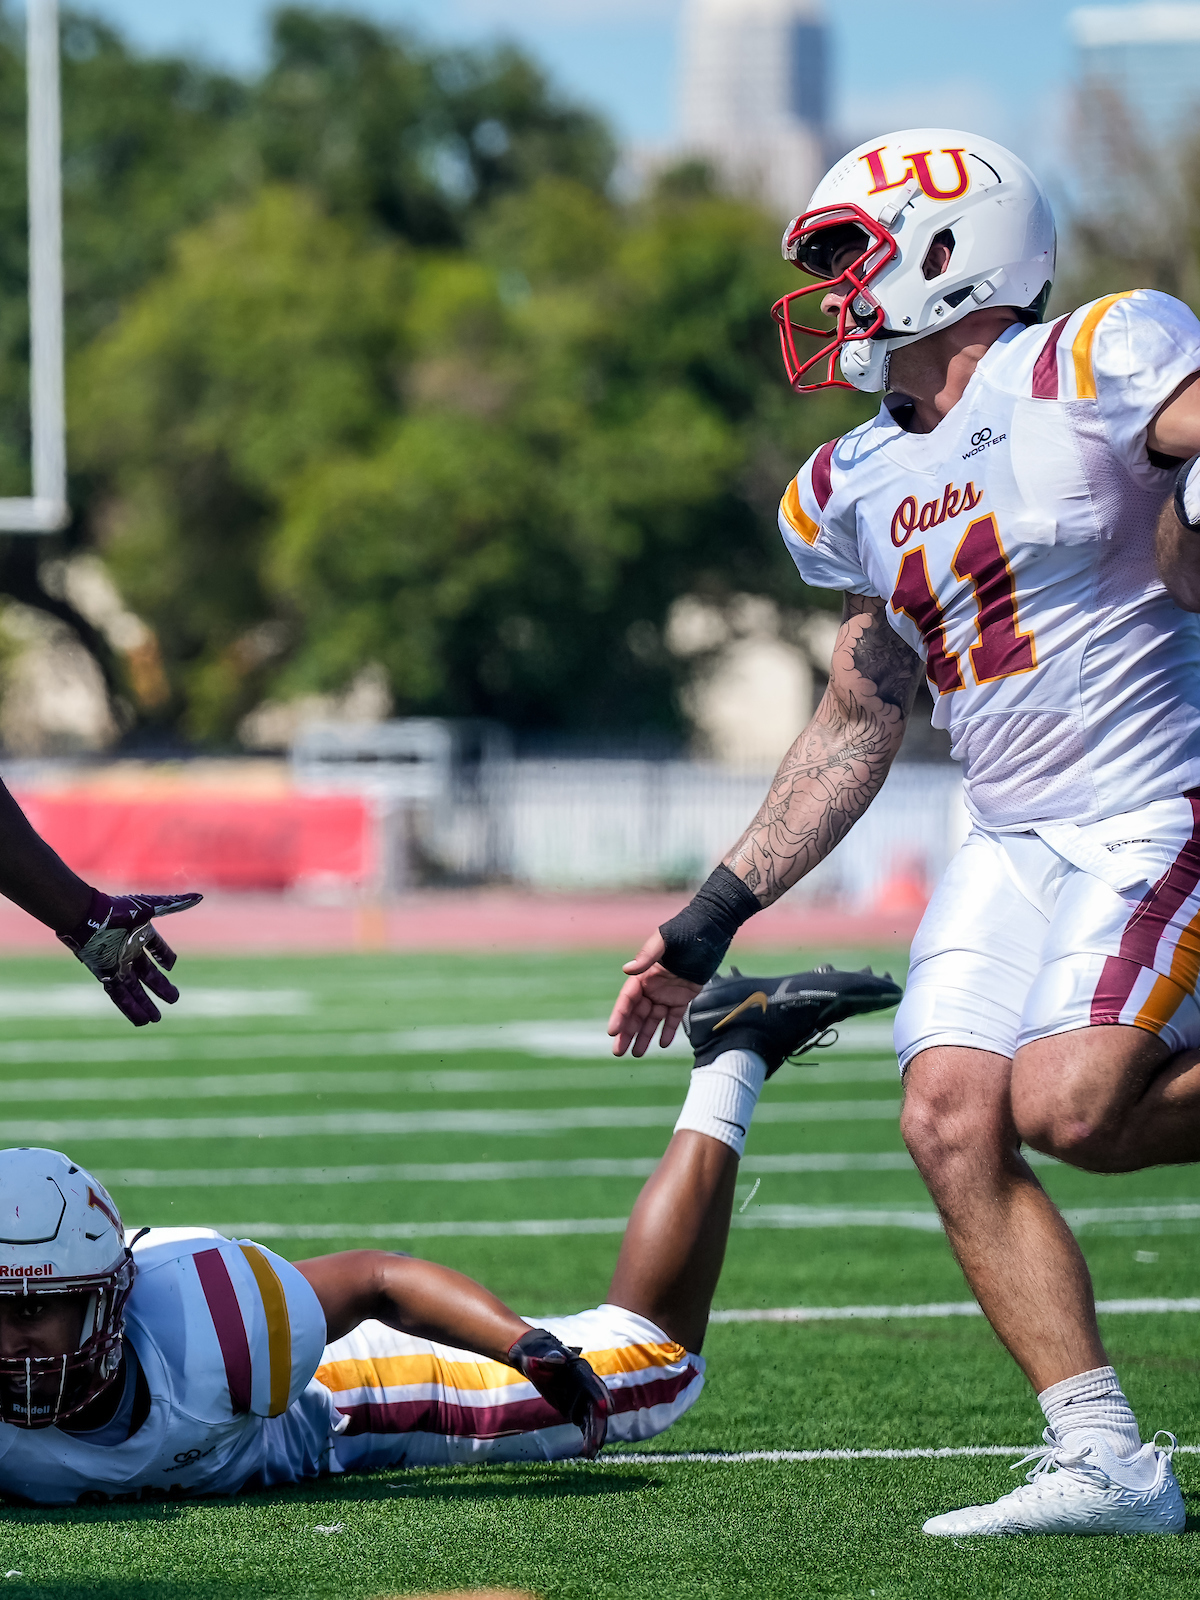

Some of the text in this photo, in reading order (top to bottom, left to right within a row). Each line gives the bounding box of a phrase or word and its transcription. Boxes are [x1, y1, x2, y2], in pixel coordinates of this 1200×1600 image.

[858, 145, 970, 201] LU
[962, 433, 1007, 460] WOOTER
[891, 481, 984, 548] Oaks
[890, 511, 1038, 696] 11
